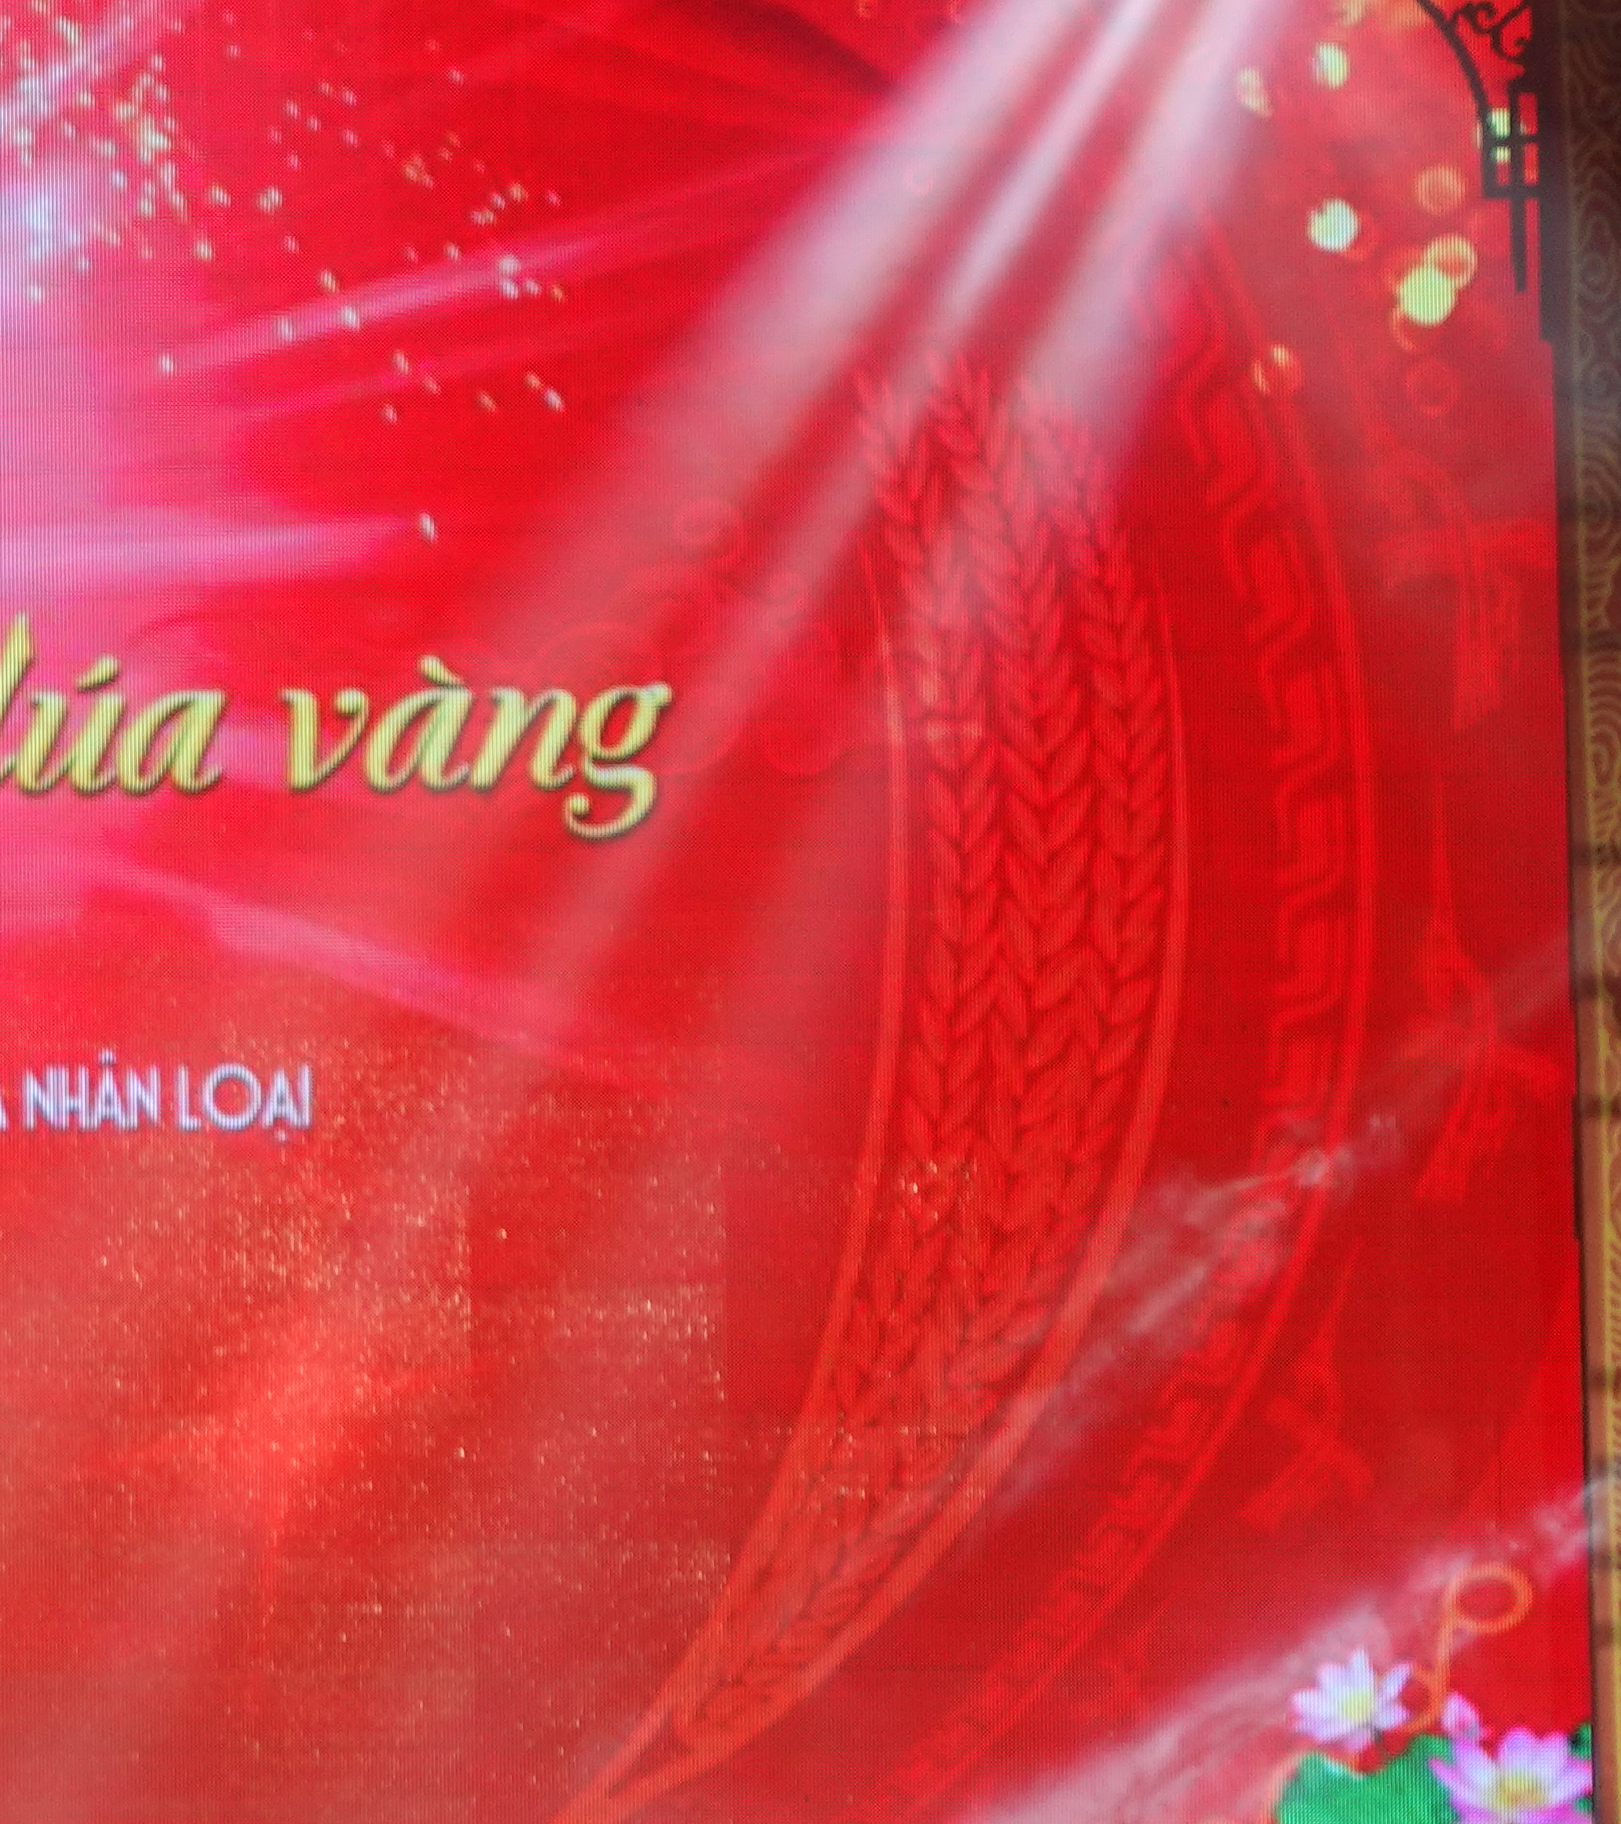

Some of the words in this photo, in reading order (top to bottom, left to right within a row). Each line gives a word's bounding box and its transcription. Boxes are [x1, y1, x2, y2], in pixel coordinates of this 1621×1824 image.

[279, 653, 674, 838] vàng
[22, 1047, 163, 1133] NHÂN
[177, 1062, 314, 1142] LOẠI
